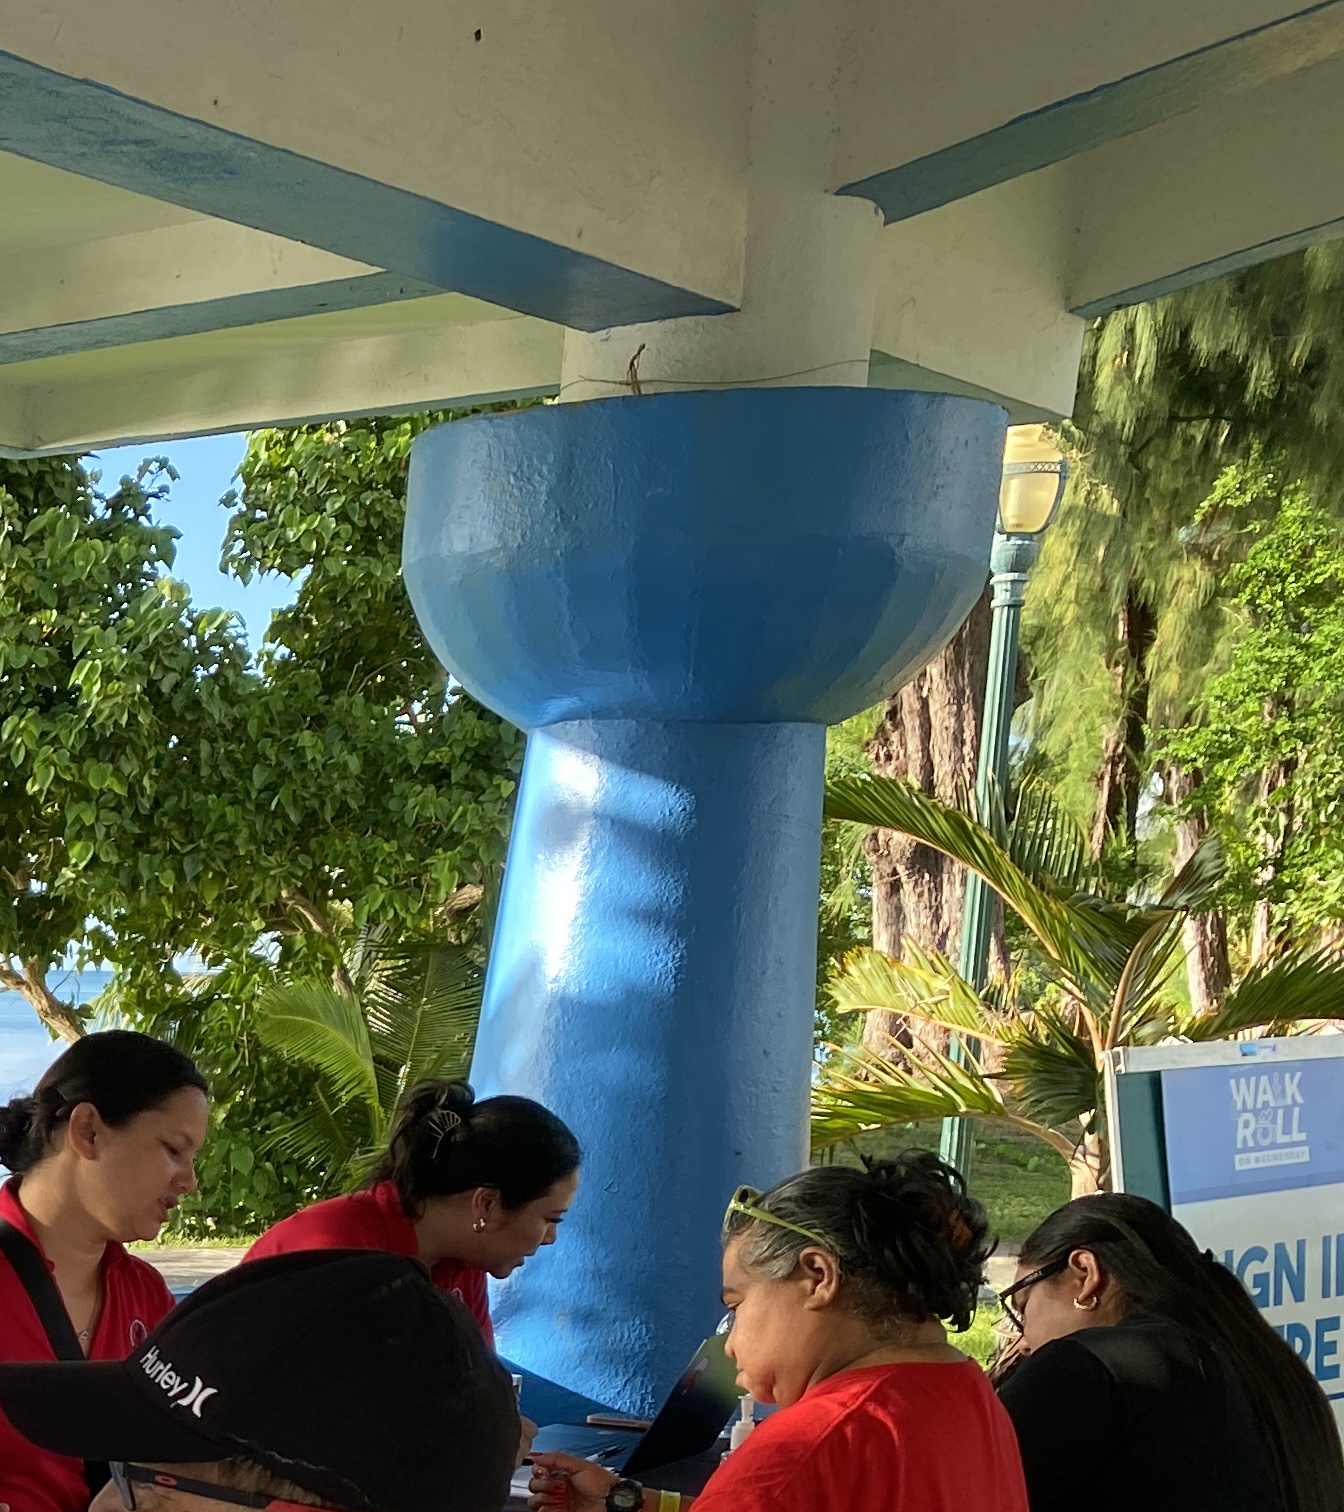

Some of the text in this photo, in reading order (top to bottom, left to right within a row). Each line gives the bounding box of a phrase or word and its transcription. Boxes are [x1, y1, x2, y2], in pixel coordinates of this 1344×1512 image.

[1230, 1071, 1305, 1112] WALK
[1322, 1233, 1344, 1298] I
[140, 1345, 189, 1397] Hurley
